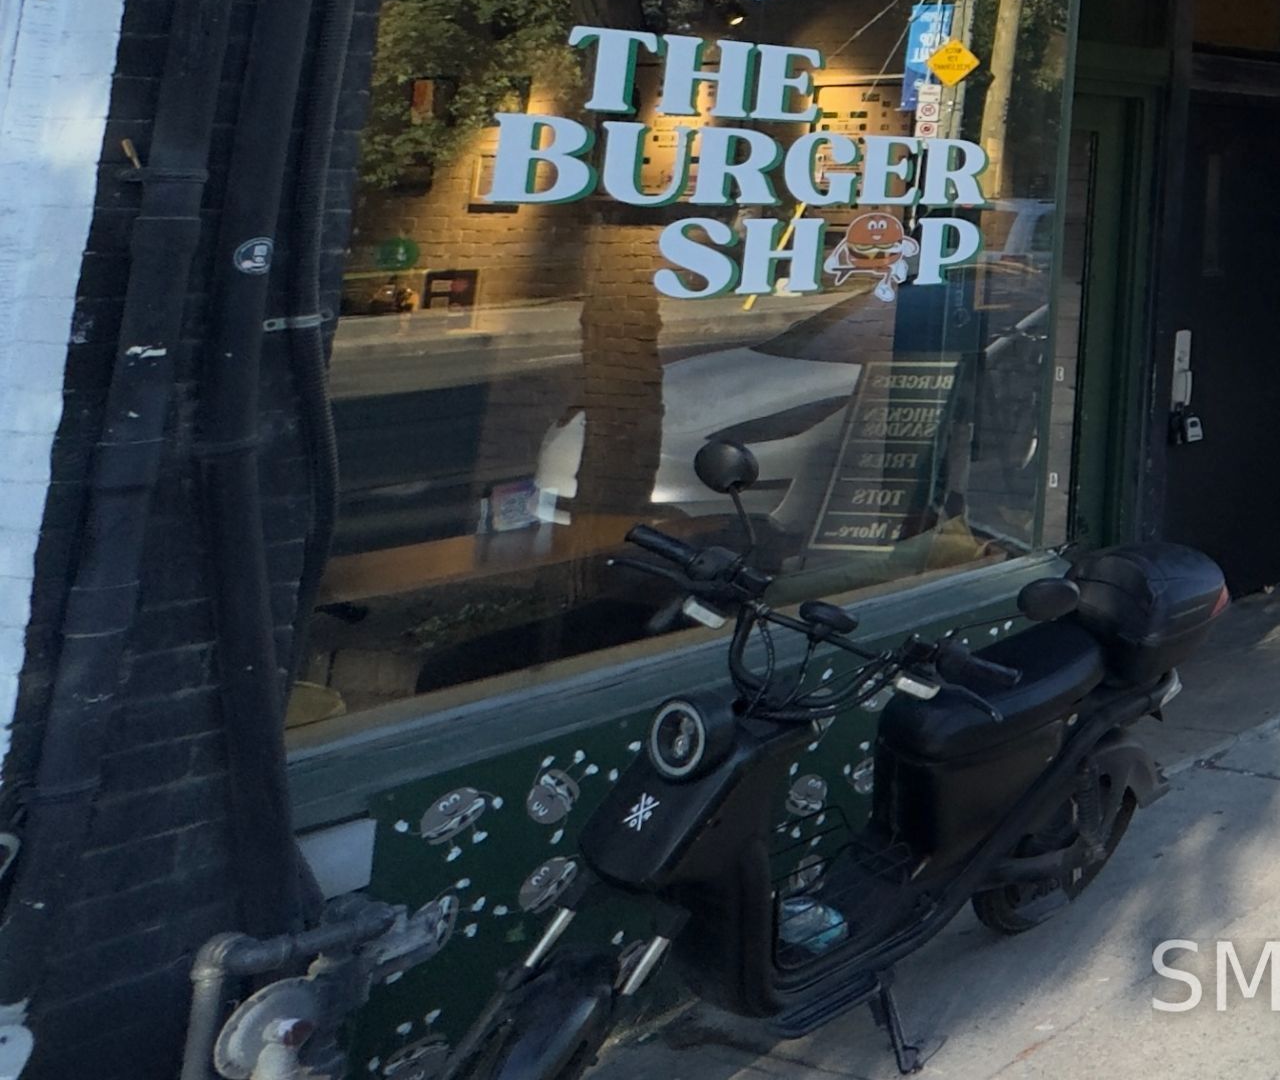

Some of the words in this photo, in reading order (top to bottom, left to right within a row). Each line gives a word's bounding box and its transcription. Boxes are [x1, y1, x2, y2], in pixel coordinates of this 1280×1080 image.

[569, 26, 825, 123] THE
[485, 112, 990, 206] BURGER
[653, 212, 984, 300] SHP
